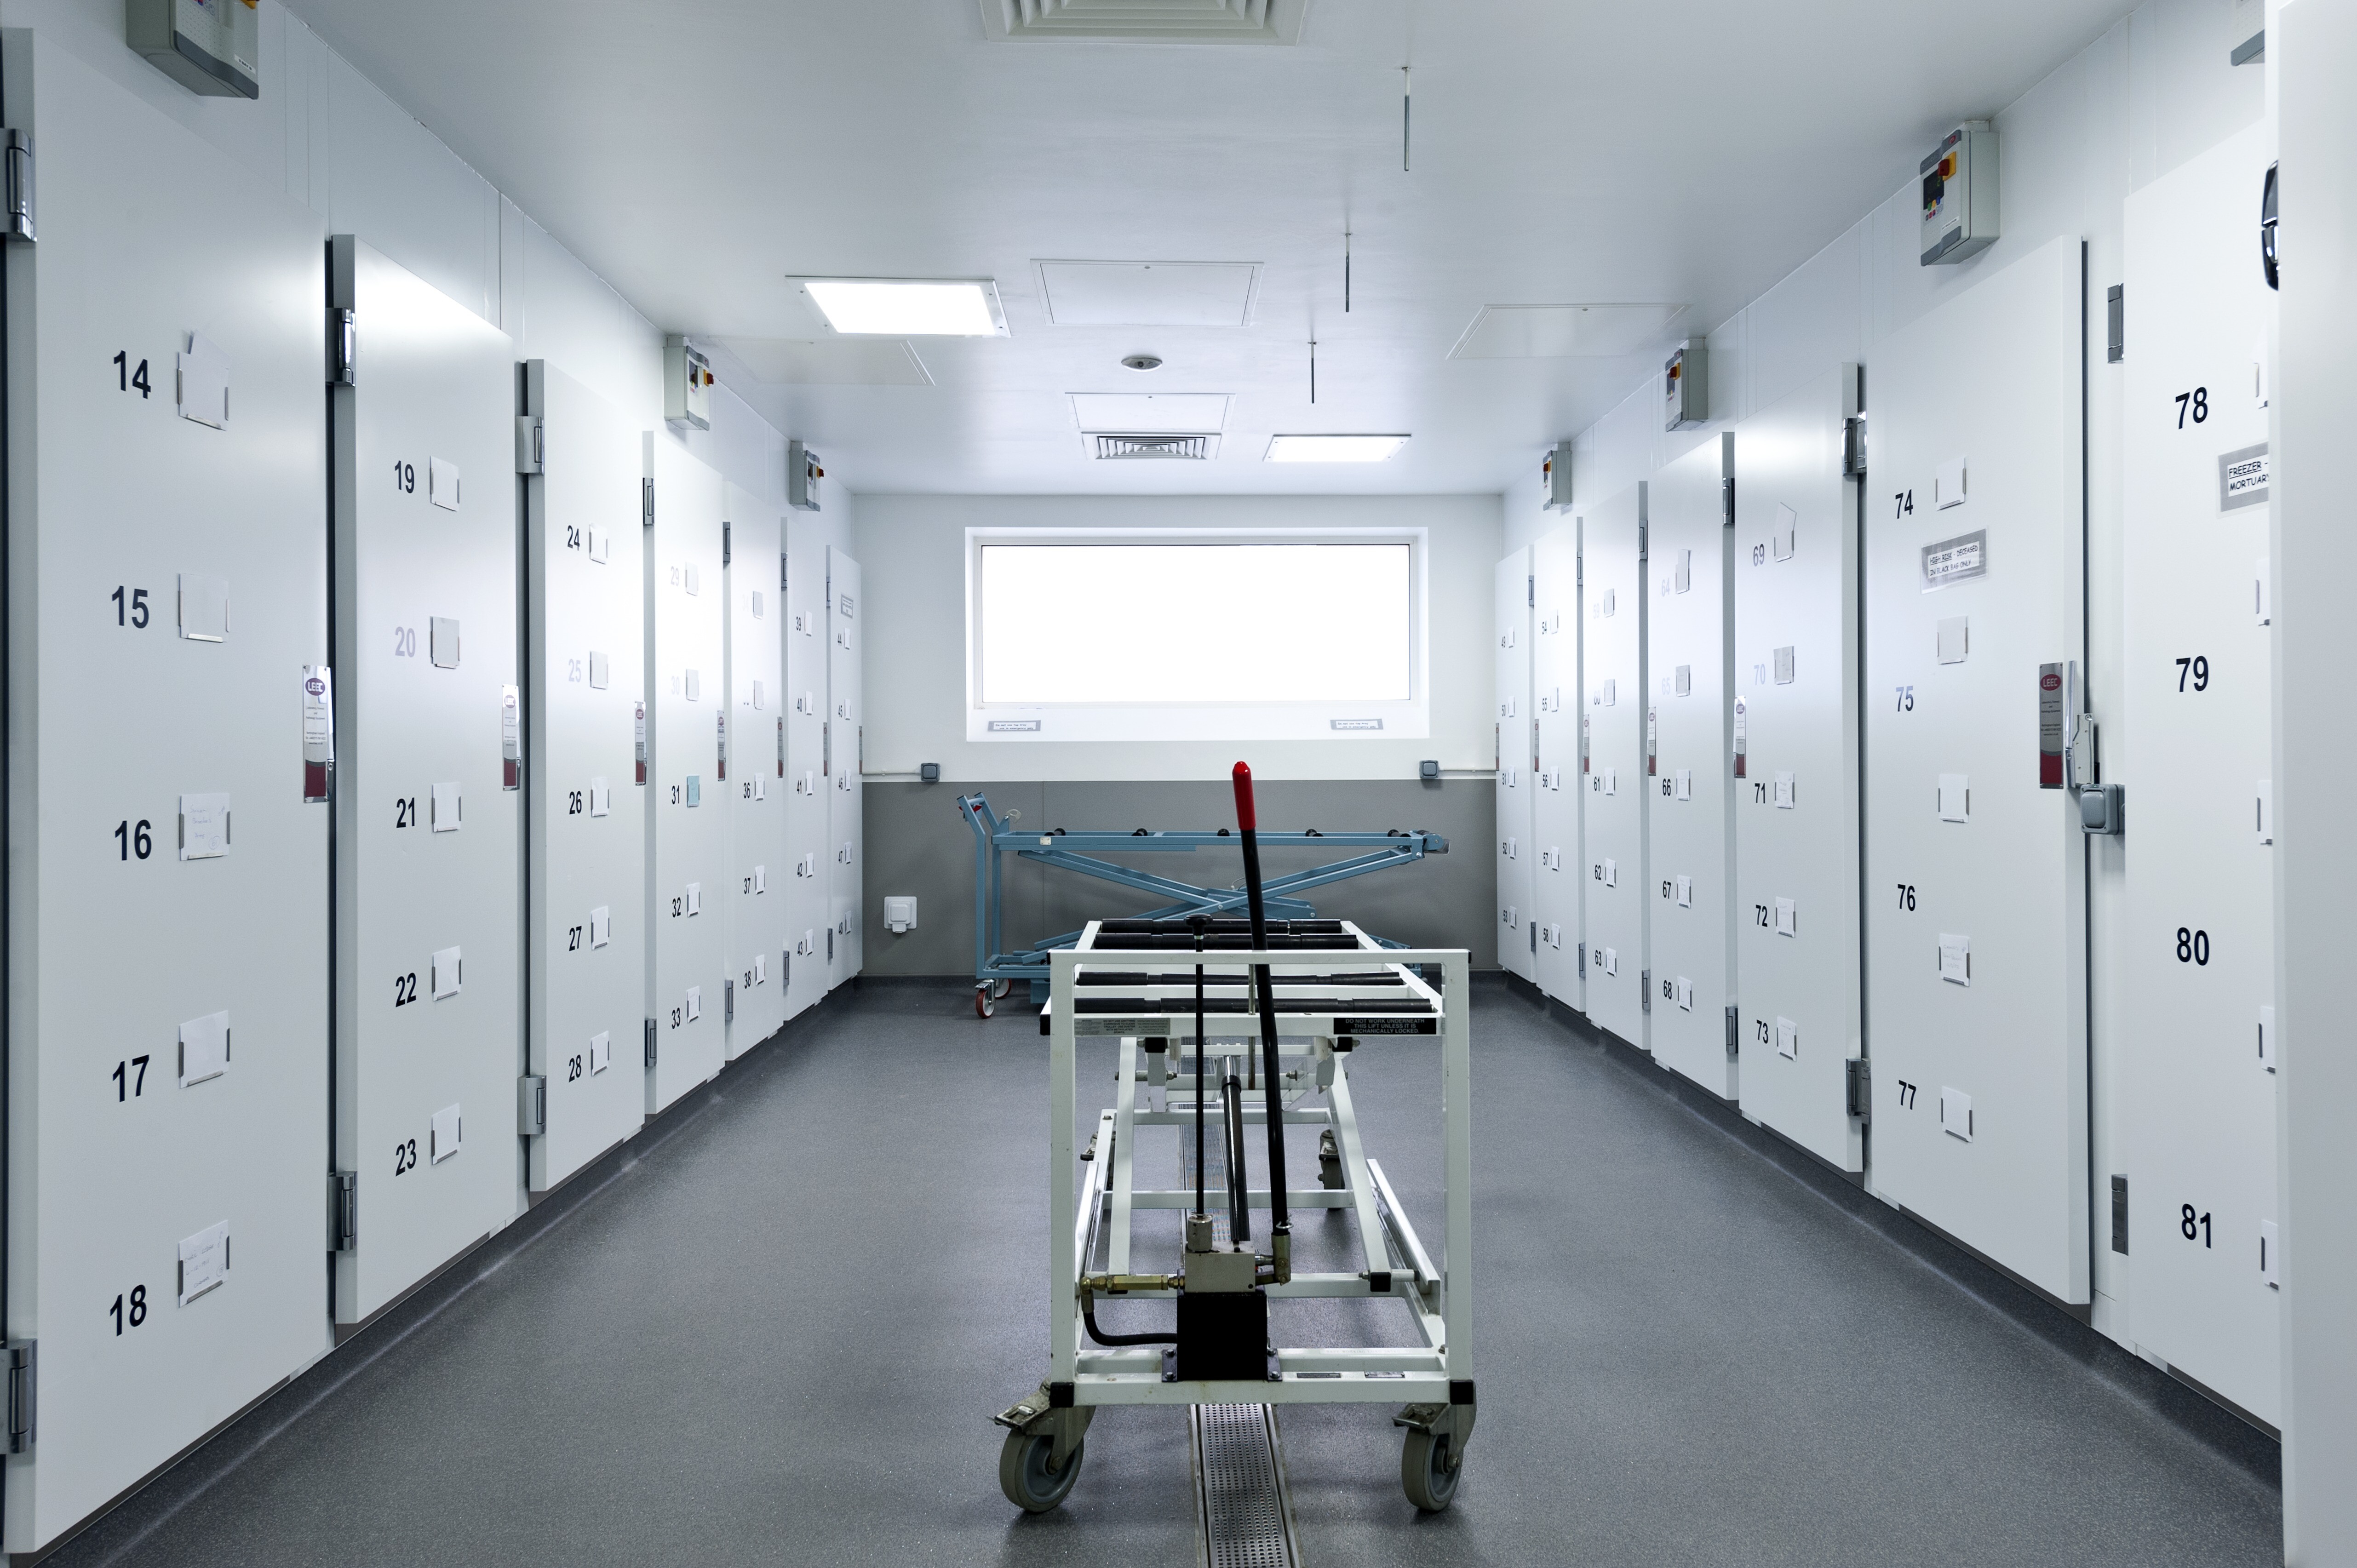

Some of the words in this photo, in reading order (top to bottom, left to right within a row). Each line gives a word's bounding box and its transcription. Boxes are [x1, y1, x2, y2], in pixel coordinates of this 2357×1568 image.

[114, 350, 151, 399] 14
[2176, 387, 2208, 429] 78
[395, 461, 414, 493] 19
[2229, 461, 2262, 477] FREEZER
[1896, 489, 1913, 519] 74
[568, 525, 580, 551] 24
[1753, 544, 1765, 567] 69
[1942, 552, 1952, 561] RISK
[1956, 545, 1978, 556] DECEASED
[671, 566, 679, 586] 29
[1937, 566, 1949, 574] BLACK
[1960, 559, 1972, 567] ONLY
[1661, 577, 1670, 597] 64
[112, 586, 149, 629] 15
[1593, 603, 1600, 619] 59
[796, 616, 801, 631] 39
[1542, 620, 1547, 635] 54
[395, 627, 415, 657] 20
[569, 659, 581, 682] 25
[1754, 664, 1766, 686] 70
[2176, 656, 2208, 692] 79
[308, 681, 323, 692] LEEC
[671, 675, 680, 696] 30
[1662, 677, 1670, 696] 65
[2042, 678, 2058, 687] LEEC
[797, 698, 802, 712] 40
[1542, 698, 1547, 711] 55
[1594, 690, 1600, 706] 60
[1896, 686, 1914, 712] 75
[838, 705, 843, 718] 45
[1502, 704, 1506, 717] 50
[797, 779, 802, 795] 41
[838, 778, 843, 790] 46
[1502, 773, 1506, 785] 51
[1543, 774, 1548, 788] 56
[1594, 776, 1600, 791] 61
[1662, 778, 1671, 796] 66
[671, 785, 680, 805] 31
[743, 782, 750, 799] 36
[1755, 783, 1766, 804] 71
[569, 791, 581, 814] 26
[396, 798, 414, 828] 21
[115, 820, 151, 860] 16
[1503, 842, 1507, 855] 52
[838, 850, 843, 863] 47
[1543, 852, 1548, 865] 57
[797, 863, 803, 877] 42
[1594, 864, 1601, 881] 62
[744, 877, 751, 894] 37
[1663, 880, 1671, 899] 67
[672, 897, 681, 918] 32
[1898, 884, 1915, 911] 76
[1503, 910, 1508, 923] 53
[1756, 905, 1767, 927] 72
[569, 925, 581, 951] 27
[1543, 927, 1549, 943] 58
[797, 941, 803, 956] 43
[2177, 927, 2209, 966] 80
[1595, 950, 1602, 967] 63
[396, 972, 416, 1007] 22
[744, 970, 751, 989] 38
[1663, 979, 1672, 1001] 68
[671, 1007, 681, 1030] 33
[1757, 1020, 1768, 1043] 73
[113, 1055, 149, 1102] 17
[569, 1055, 581, 1082] 28
[1899, 1080, 1916, 1110] 77
[396, 1139, 416, 1176] 23
[2182, 1204, 2211, 1248] 81
[110, 1285, 147, 1336] 18
